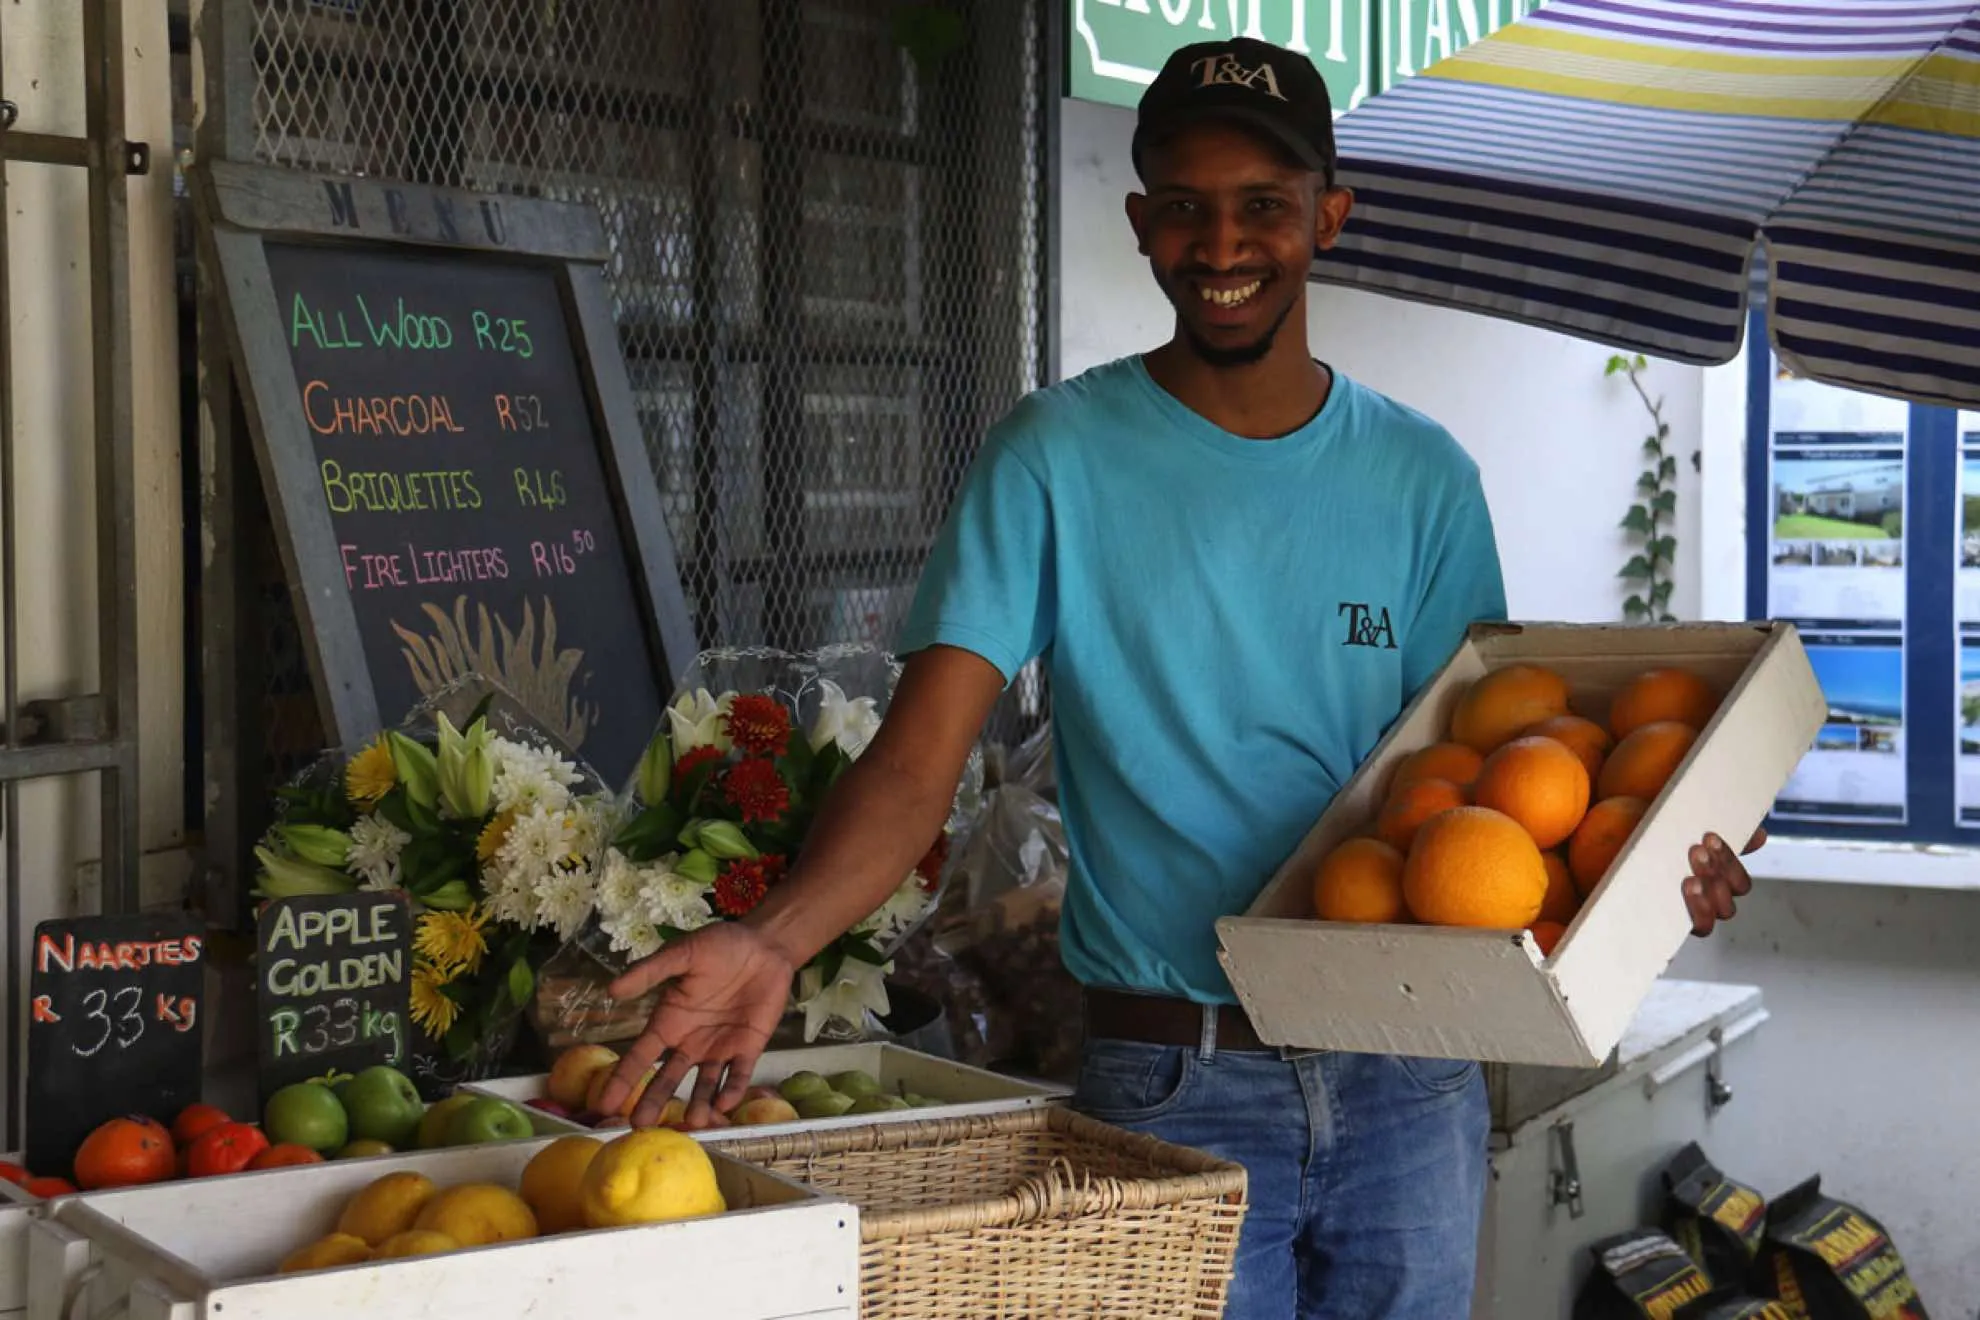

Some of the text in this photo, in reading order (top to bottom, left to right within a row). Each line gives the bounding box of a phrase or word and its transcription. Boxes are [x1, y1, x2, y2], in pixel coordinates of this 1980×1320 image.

[1190, 53, 1289, 102] T&A
[293, 293, 534, 358] ALL WOOD R25
[304, 380, 549, 436] CHARCOAL R52
[321, 459, 567, 513] BRIQUETTES R46
[341, 544, 408, 590] FIRE
[409, 543, 509, 585] LIGHTERS
[1338, 602, 1399, 649] T&A
[267, 904, 398, 952] APPLE
[267, 950, 402, 996] GOLDEN
[33, 994, 62, 1023] R
[72, 987, 145, 1057] 33
